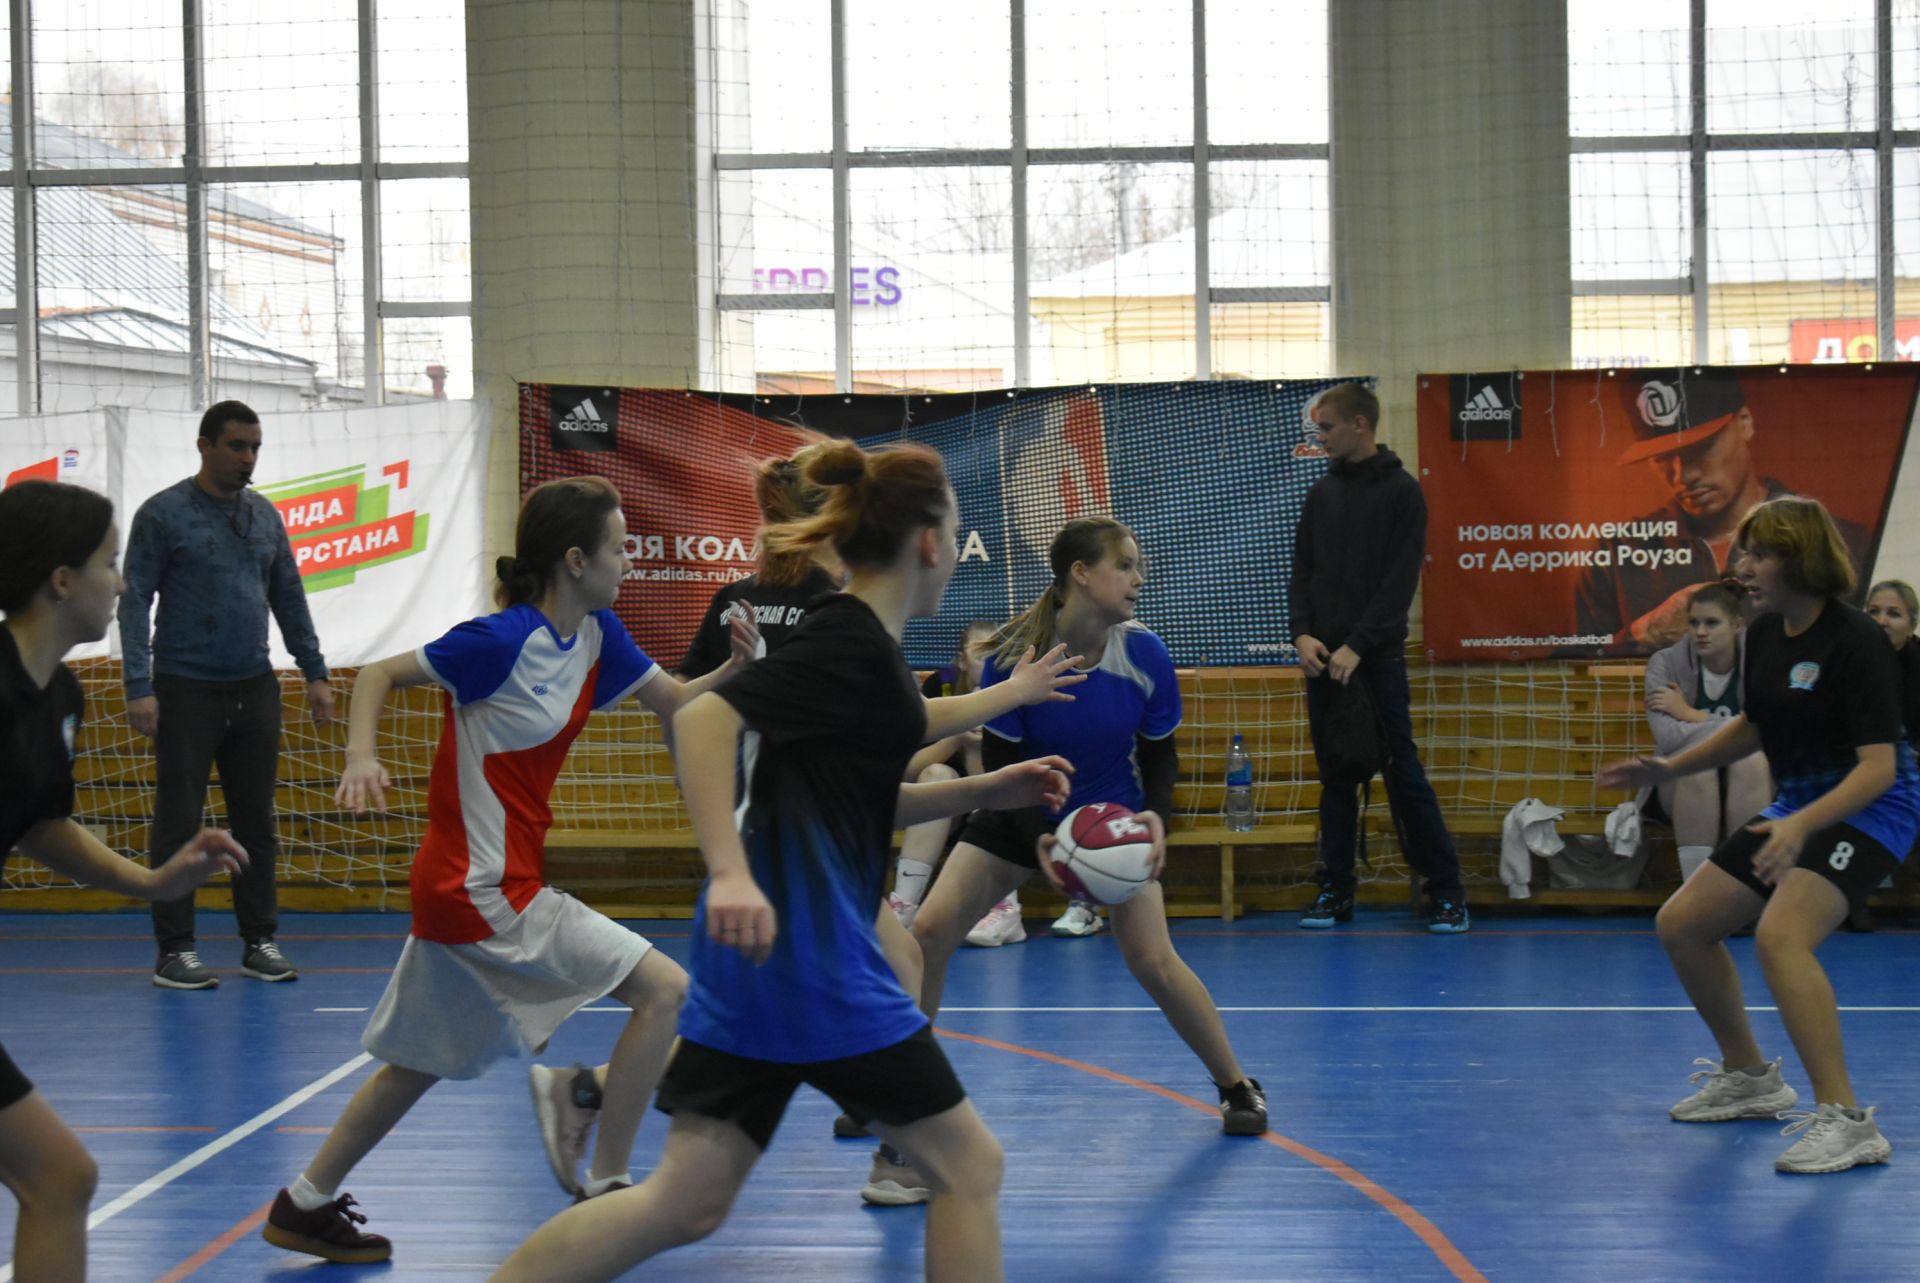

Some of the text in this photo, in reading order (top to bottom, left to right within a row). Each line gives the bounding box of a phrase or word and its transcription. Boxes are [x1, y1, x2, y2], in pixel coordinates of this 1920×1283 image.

[1459, 407, 1512, 421] adidas
[559, 419, 609, 433] adidas
[1458, 520, 1678, 541] новая коллекция
[1459, 545, 1693, 572] от Деррика Роуза
[1461, 632, 1614, 647] www.adidas.ru/basketball
[1828, 841, 1855, 871] 8
